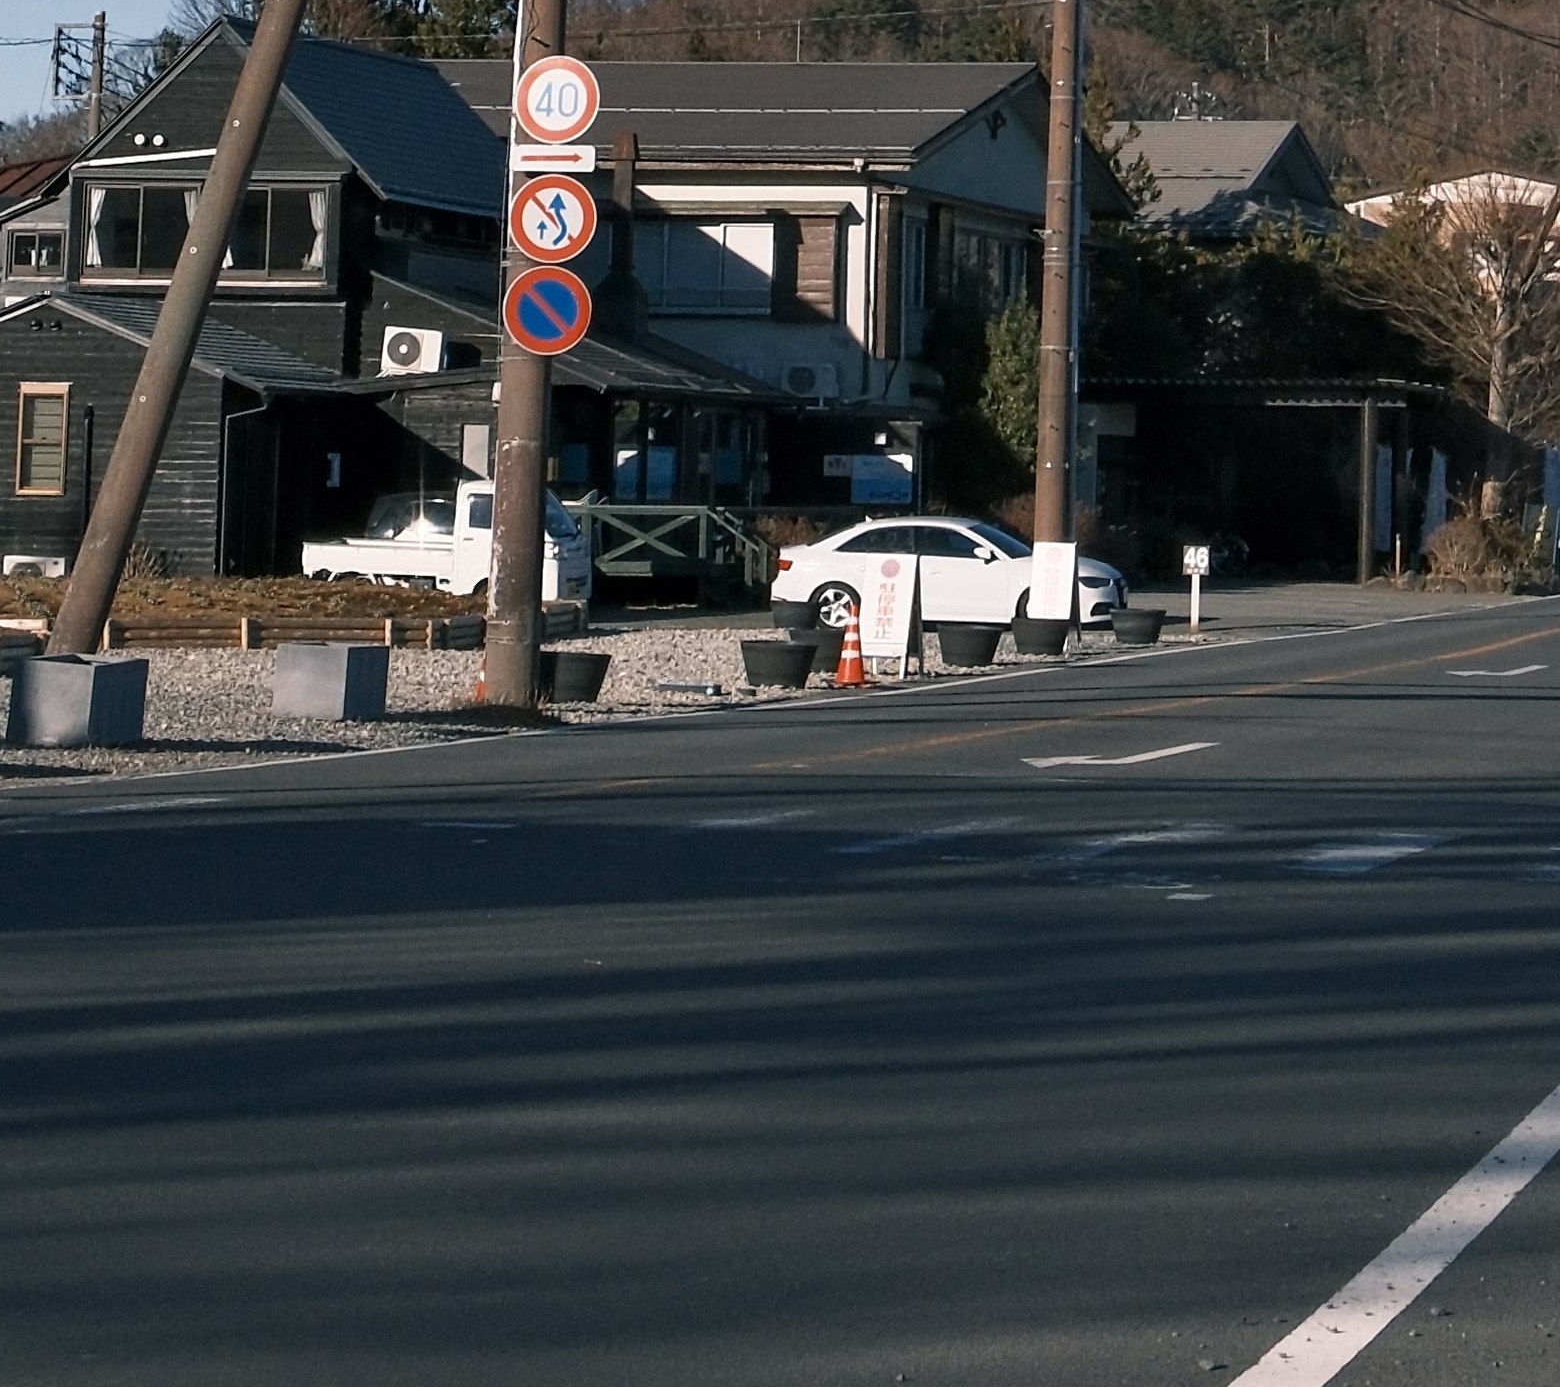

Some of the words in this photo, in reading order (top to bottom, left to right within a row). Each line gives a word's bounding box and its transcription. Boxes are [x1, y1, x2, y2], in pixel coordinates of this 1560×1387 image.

[534, 82, 579, 117] 40
[1183, 547, 1209, 568] 46
[872, 582, 897, 640] 駐停車禁止
